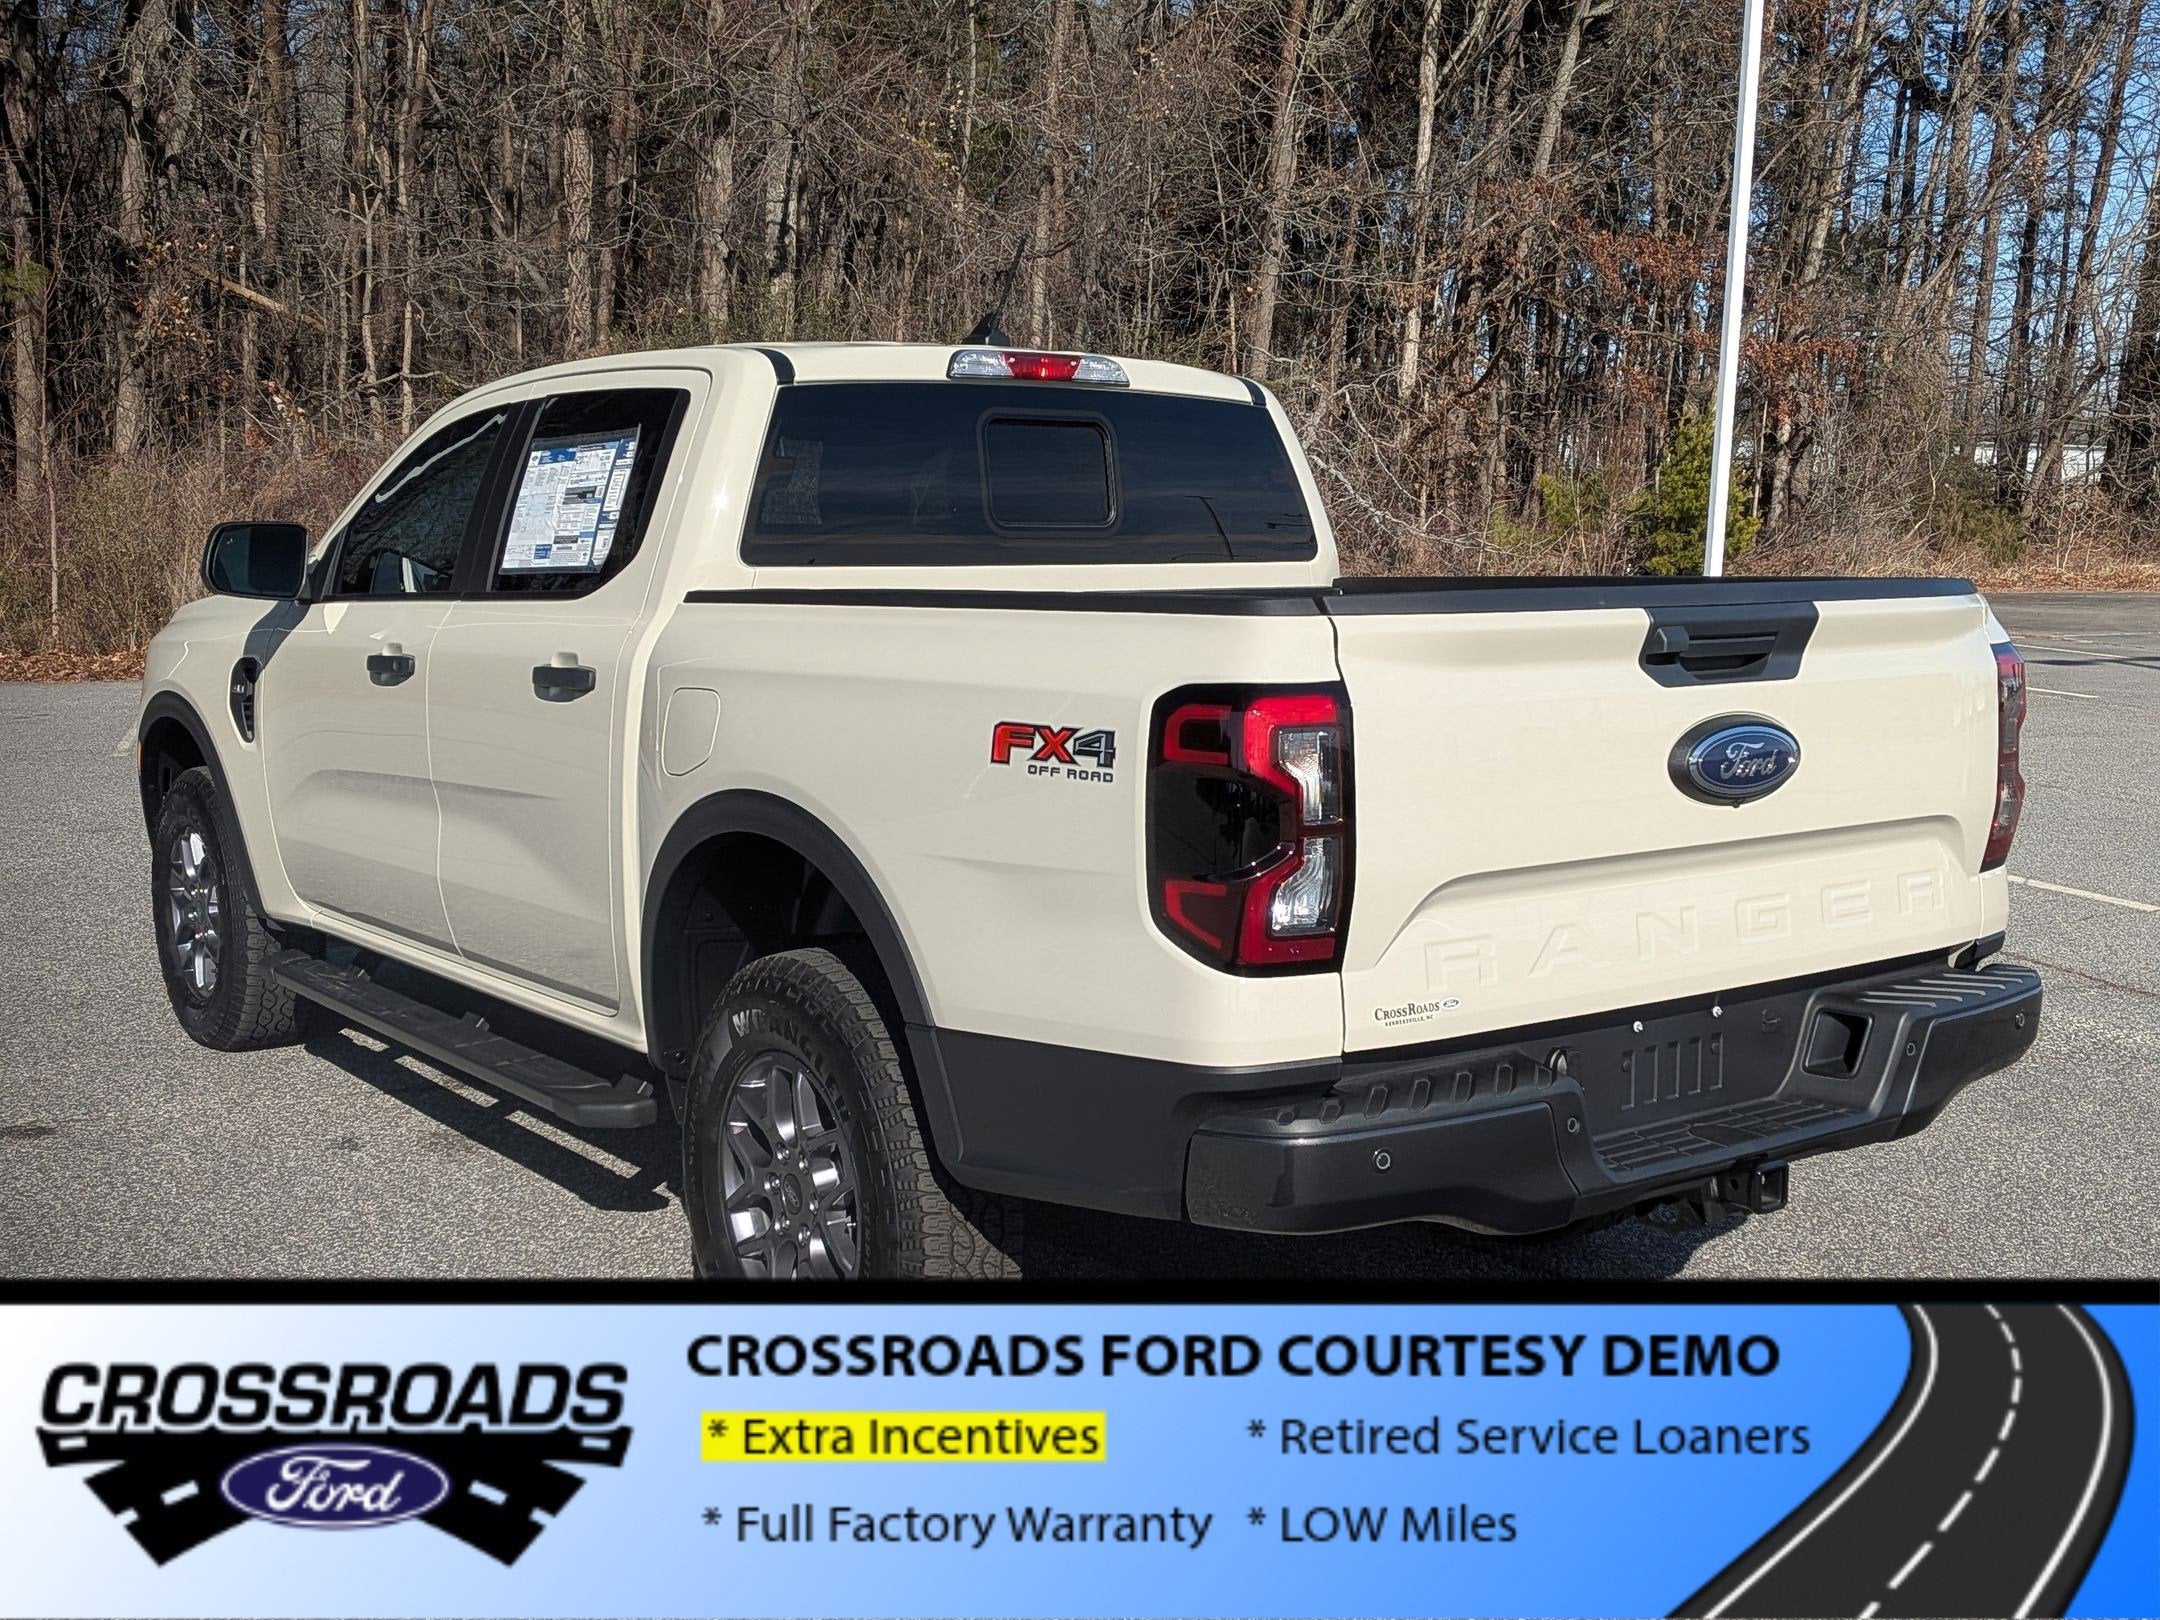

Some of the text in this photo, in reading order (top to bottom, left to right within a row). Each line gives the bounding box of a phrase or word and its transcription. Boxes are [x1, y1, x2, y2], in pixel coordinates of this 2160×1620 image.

[991, 721, 1116, 768] FX4
[1719, 741, 1779, 780] Ford
[1027, 764, 1114, 783] OFF ROAD
[1424, 866, 1946, 992] RANGER
